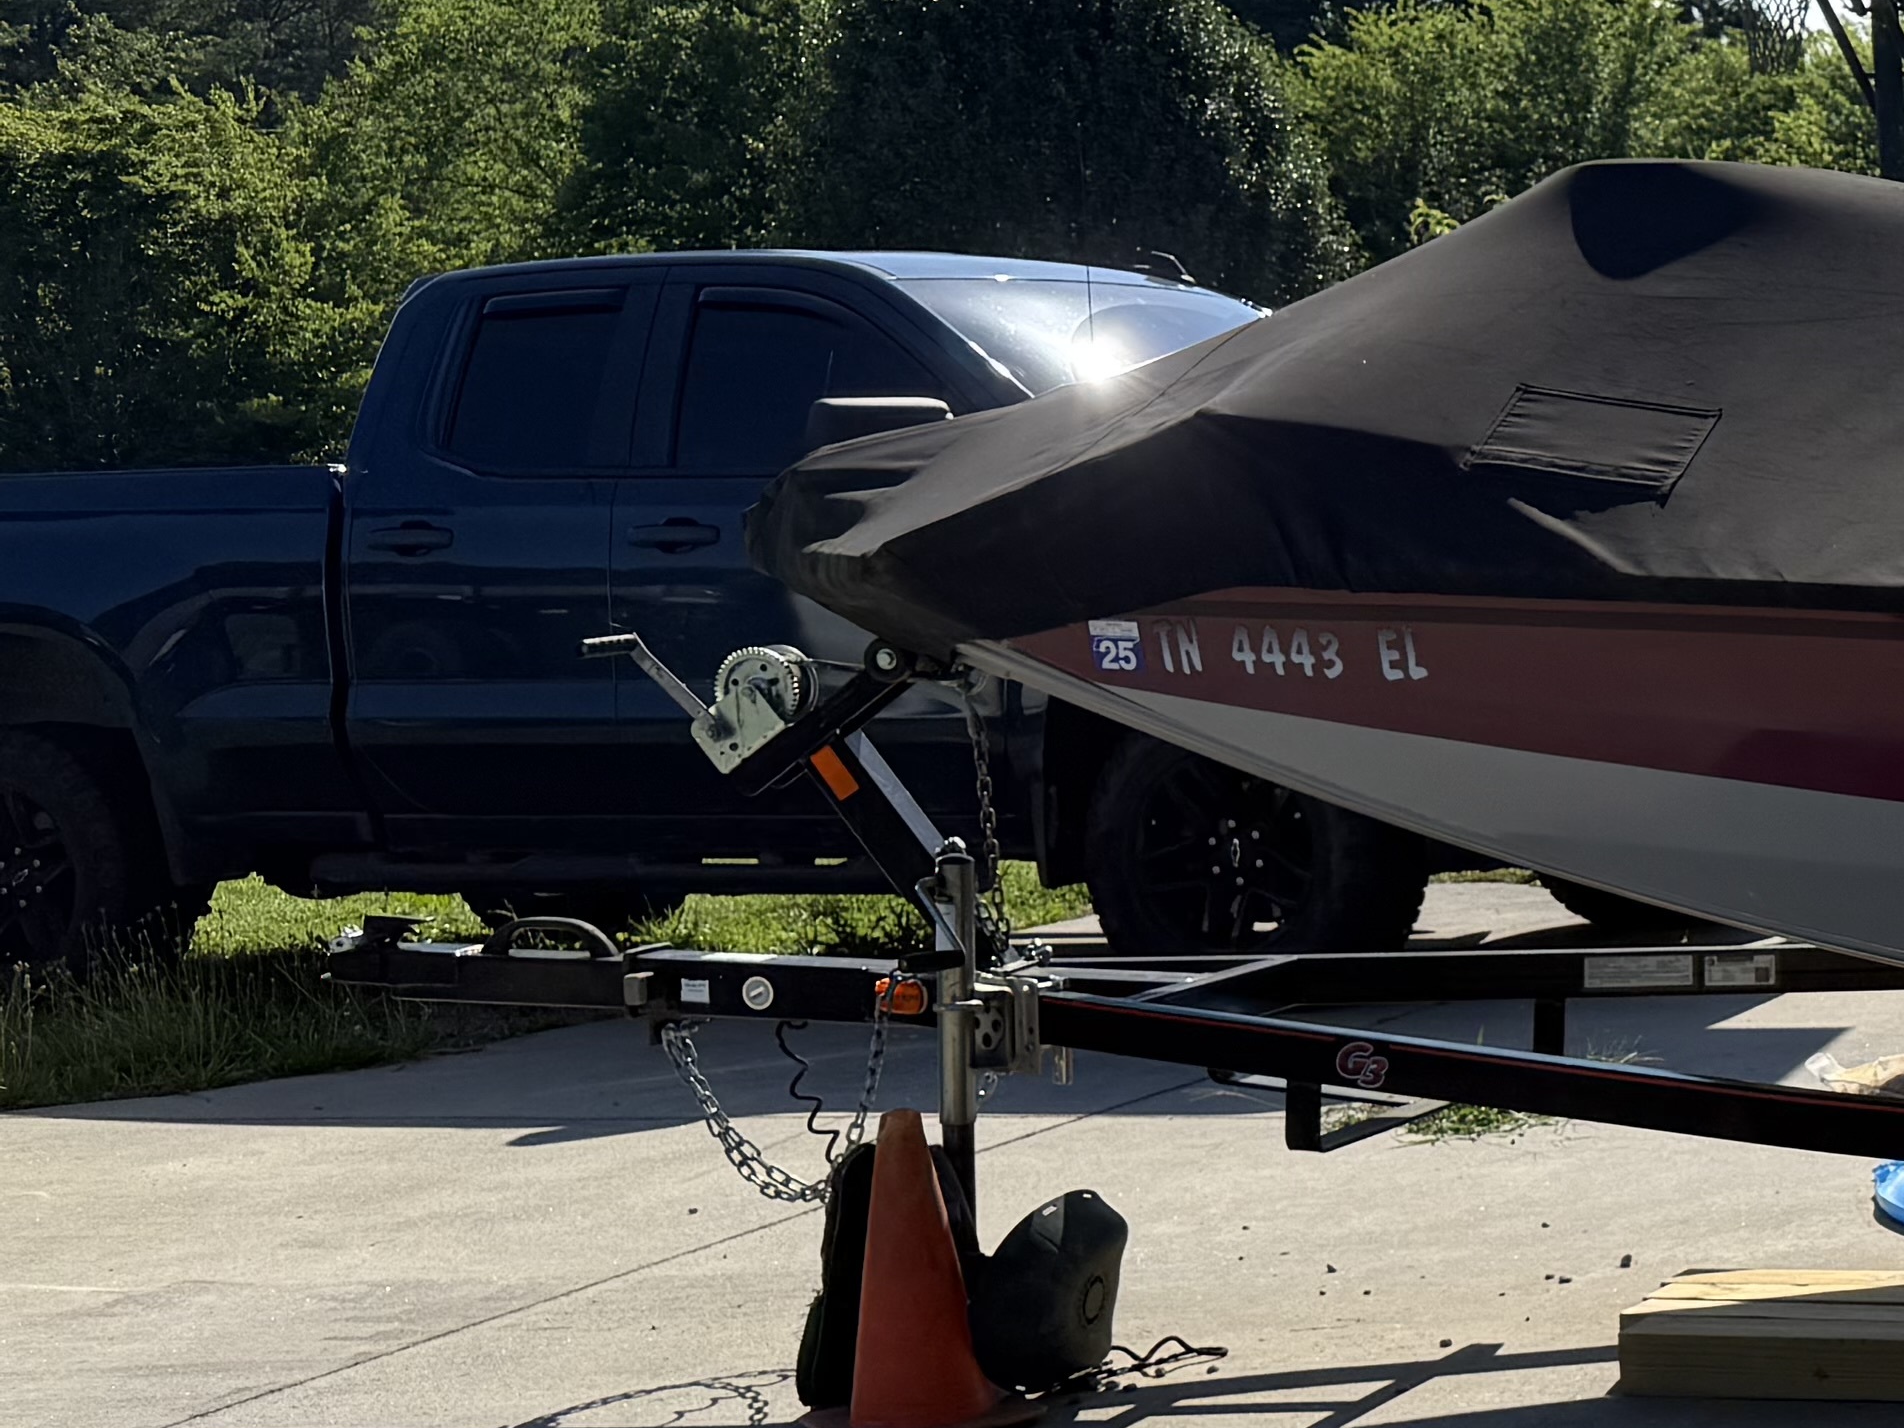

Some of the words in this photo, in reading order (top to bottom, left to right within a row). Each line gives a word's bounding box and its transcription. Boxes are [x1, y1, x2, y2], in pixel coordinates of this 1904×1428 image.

[1099, 640, 1137, 670] 25
[1153, 619, 1202, 675] TN
[1232, 626, 1343, 679] 4443
[1377, 627, 1428, 681] EL
[1336, 1041, 1389, 1088] G3
